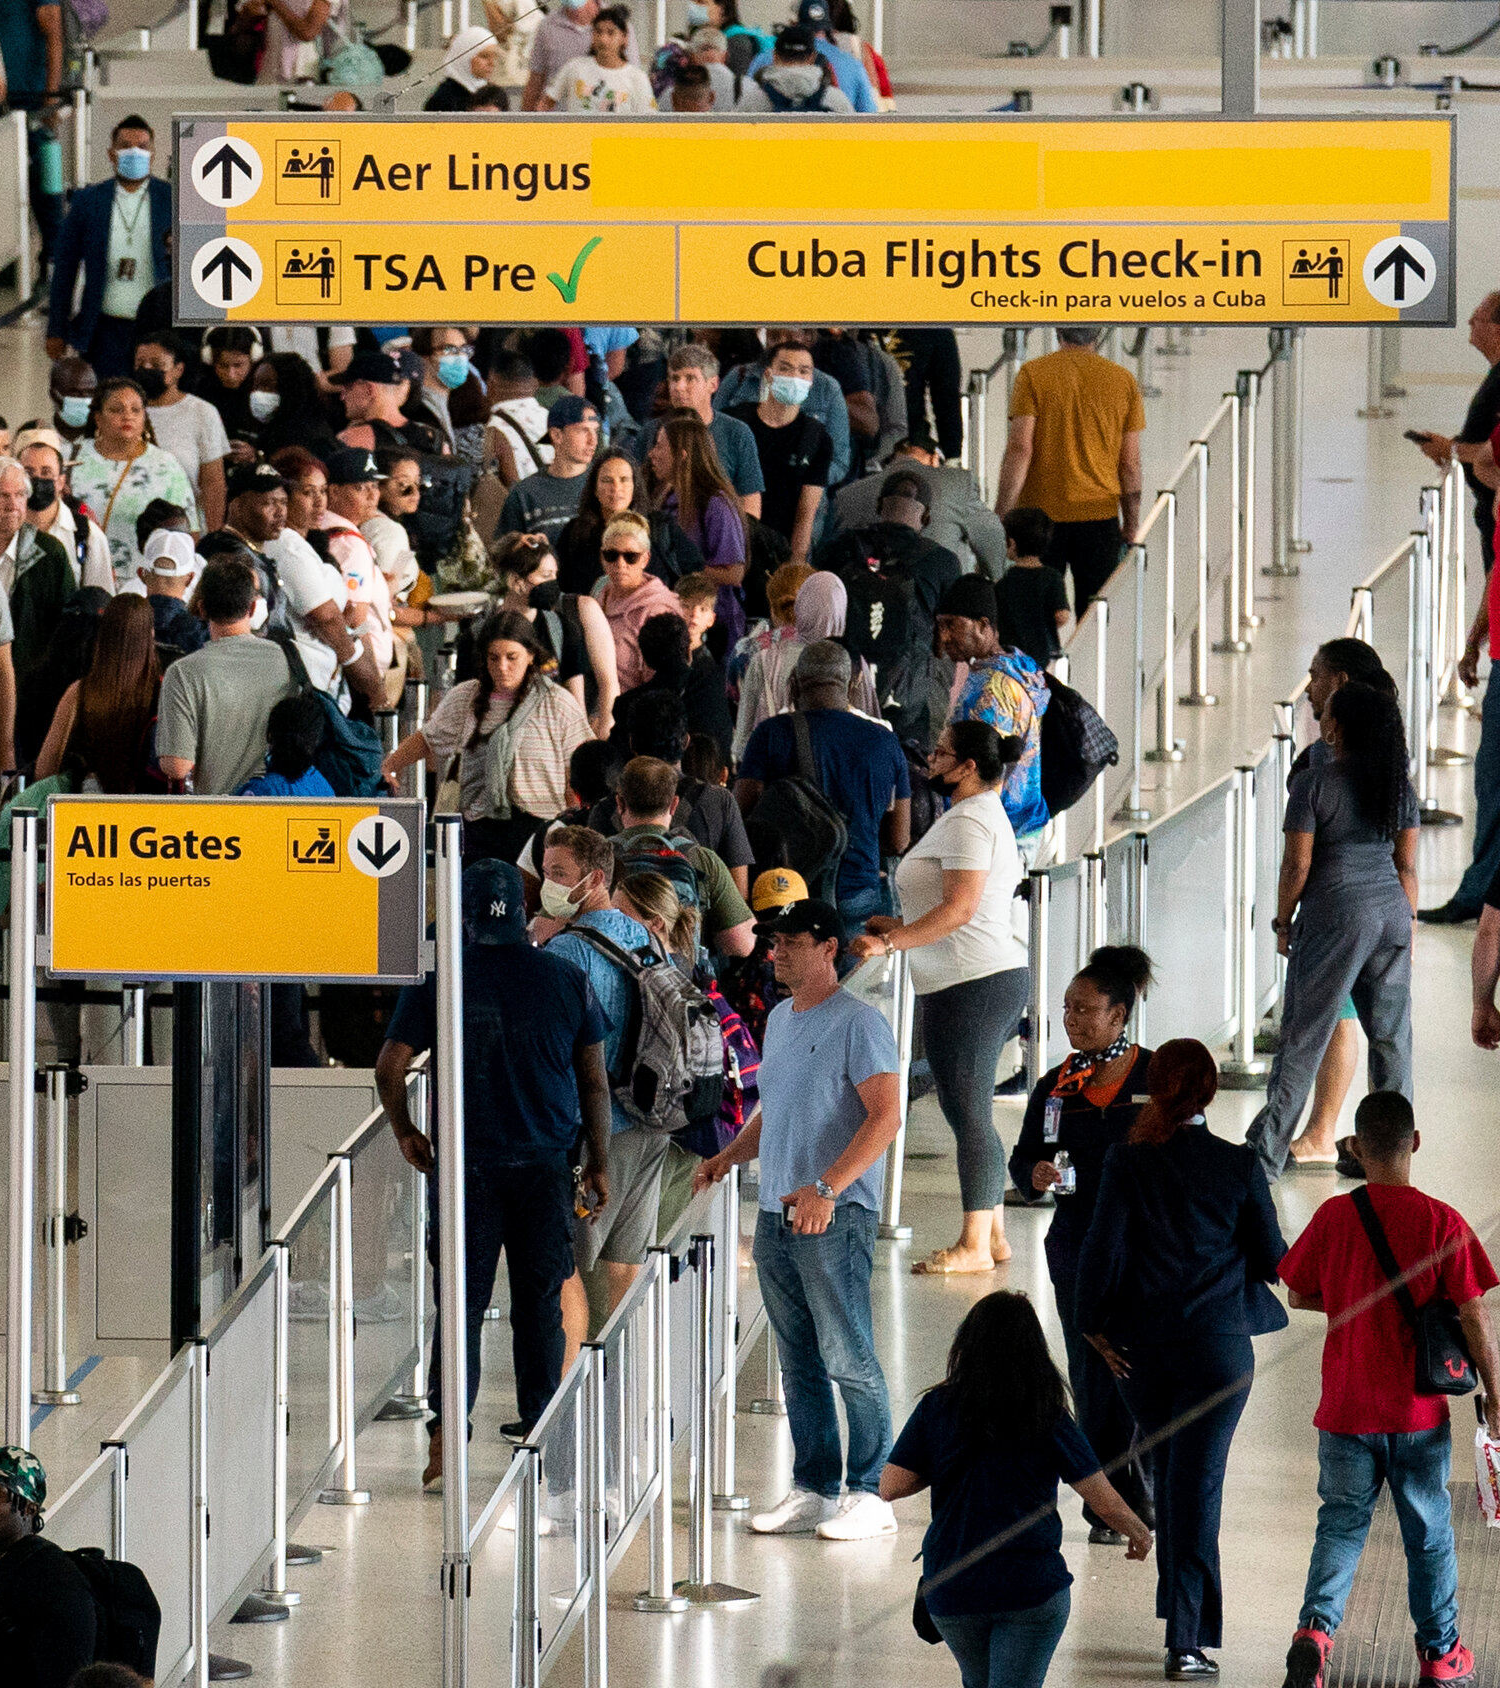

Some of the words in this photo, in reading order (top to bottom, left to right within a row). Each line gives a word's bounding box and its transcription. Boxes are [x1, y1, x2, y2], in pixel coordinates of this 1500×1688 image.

[353, 155, 431, 190] Aer
[449, 153, 590, 201] Lingus
[355, 255, 446, 291] TSA
[465, 256, 535, 291] Pre
[749, 239, 865, 277] Cuba
[887, 239, 1040, 288] Flights
[1060, 239, 1260, 278] Check-in
[971, 291, 1057, 307] Check-in
[1067, 296, 1110, 311] para
[1120, 291, 1186, 307] vuelos
[1195, 296, 1204, 307] a
[1214, 290, 1265, 307] Cuba
[68, 825, 117, 857] All
[130, 827, 241, 859] Gates
[68, 873, 113, 886] Todas
[121, 873, 141, 886] las
[149, 875, 210, 889] puertas
